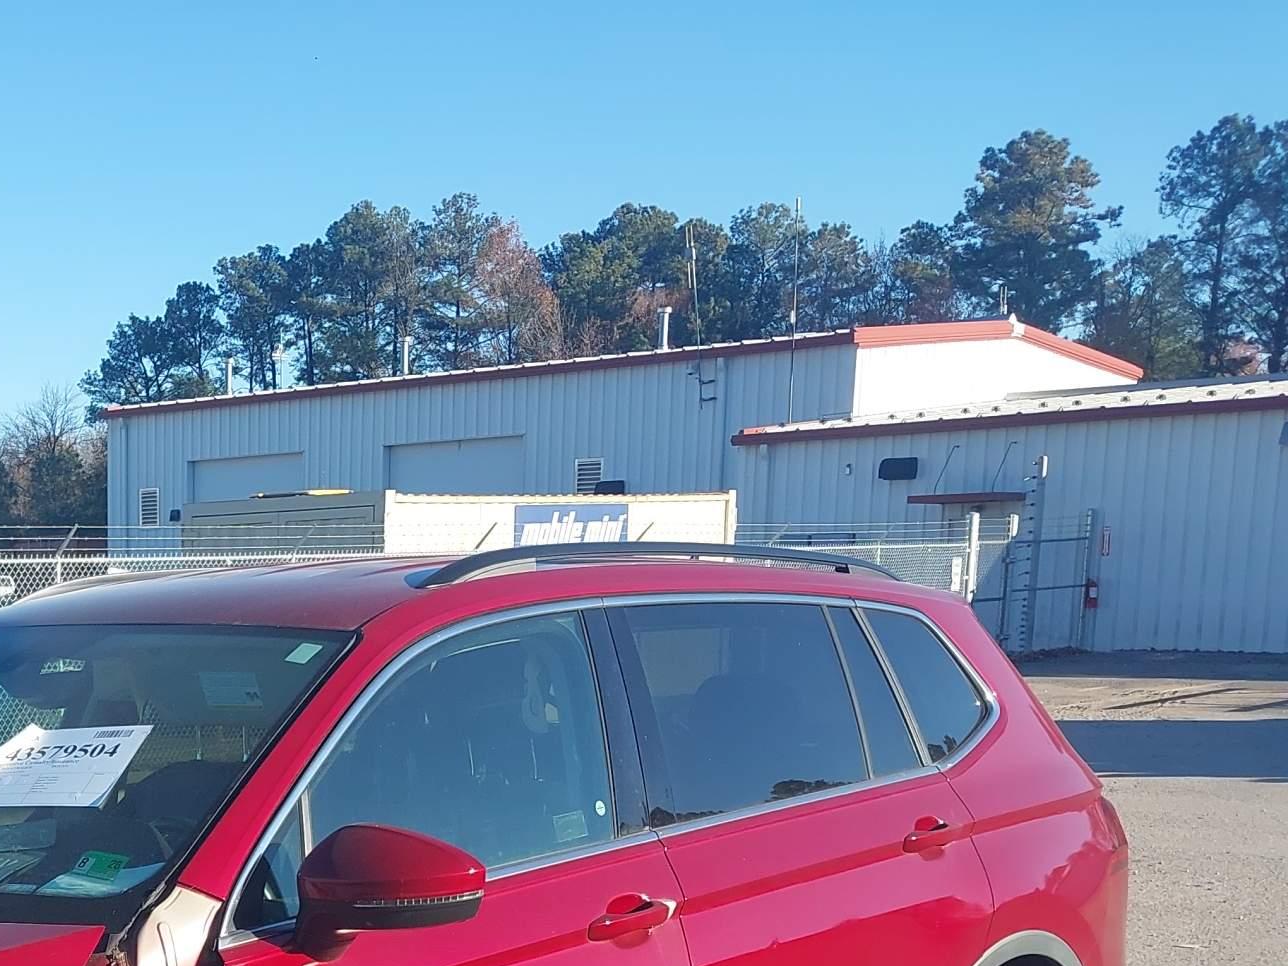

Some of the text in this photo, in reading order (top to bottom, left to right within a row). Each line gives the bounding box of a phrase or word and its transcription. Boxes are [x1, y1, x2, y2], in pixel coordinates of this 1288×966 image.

[520, 511, 628, 546] mobile mini
[5, 742, 122, 762] 43579504
